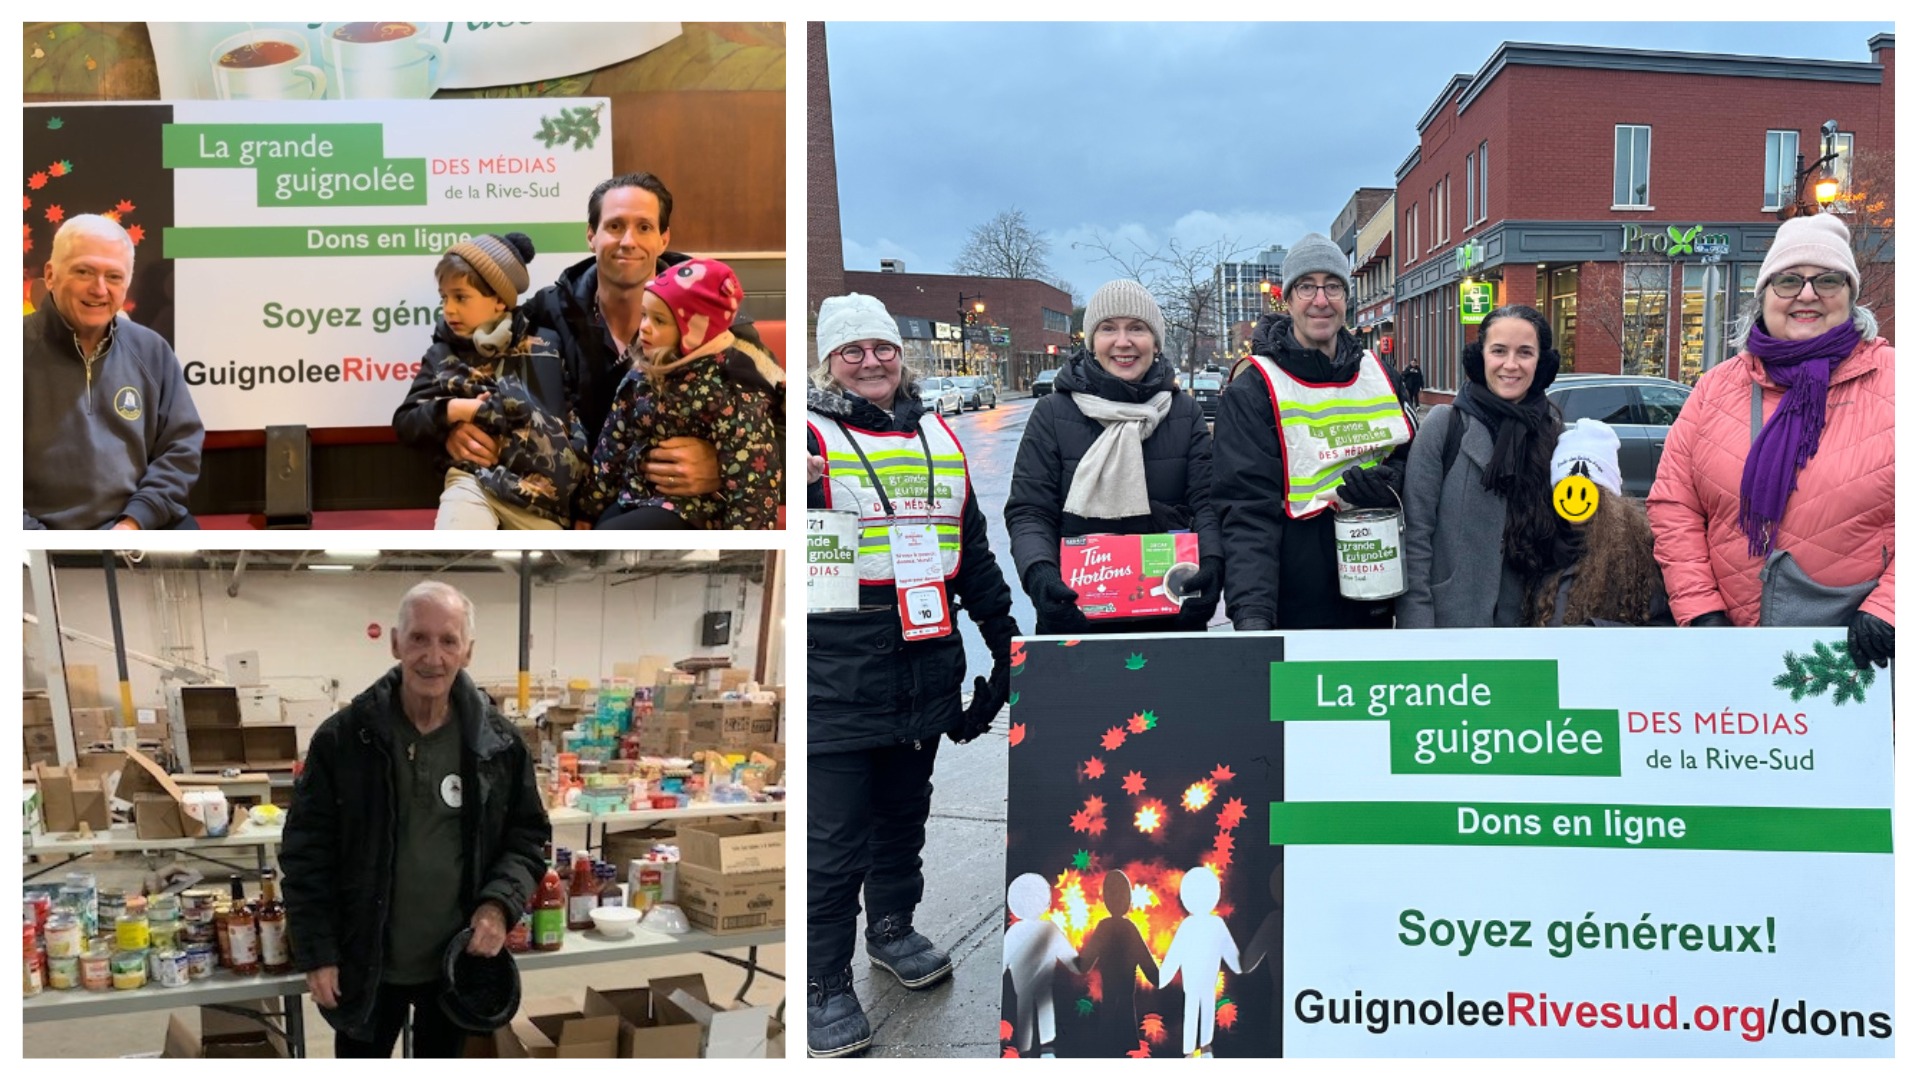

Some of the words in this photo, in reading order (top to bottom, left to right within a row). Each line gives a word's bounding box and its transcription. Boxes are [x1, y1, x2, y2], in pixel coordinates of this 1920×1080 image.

[199, 133, 230, 158] La
[239, 133, 333, 165] grande
[432, 158, 470, 175] DES
[479, 154, 556, 174] MÉDIAS
[275, 164, 415, 199] guignolée
[445, 185, 463, 199] de
[469, 184, 480, 198] la
[486, 182, 560, 198] Rive-Sud
[307, 229, 369, 249] Dons
[377, 232, 406, 248] en
[415, 229, 472, 252] ligne
[263, 302, 362, 334] Soyez
[372, 300, 443, 333] géné
[183, 356, 422, 391] GuignoleeRives
[1329, 422, 1364, 436] grande
[1318, 449, 1339, 460] DES
[873, 499, 897, 512] DS
[1080, 545, 1111, 566] Tim
[1070, 565, 1132, 588] Hortons
[1317, 674, 1355, 707] La
[1367, 673, 1491, 716] grande
[1627, 711, 1682, 733] DES
[1694, 707, 1808, 735] MÉDIAS
[1414, 717, 1603, 764] guignolée
[1646, 749, 1672, 768] de
[1681, 749, 1697, 769] la
[1706, 748, 1814, 770] Rive-Sud
[1457, 807, 1541, 835] Dons
[1552, 813, 1591, 836] en
[1604, 809, 1686, 844] ligne
[1398, 909, 1532, 957] Soyez
[1547, 911, 1777, 958] généreux!
[1294, 989, 1893, 1042] GuignoleeRivesud.org/dons
